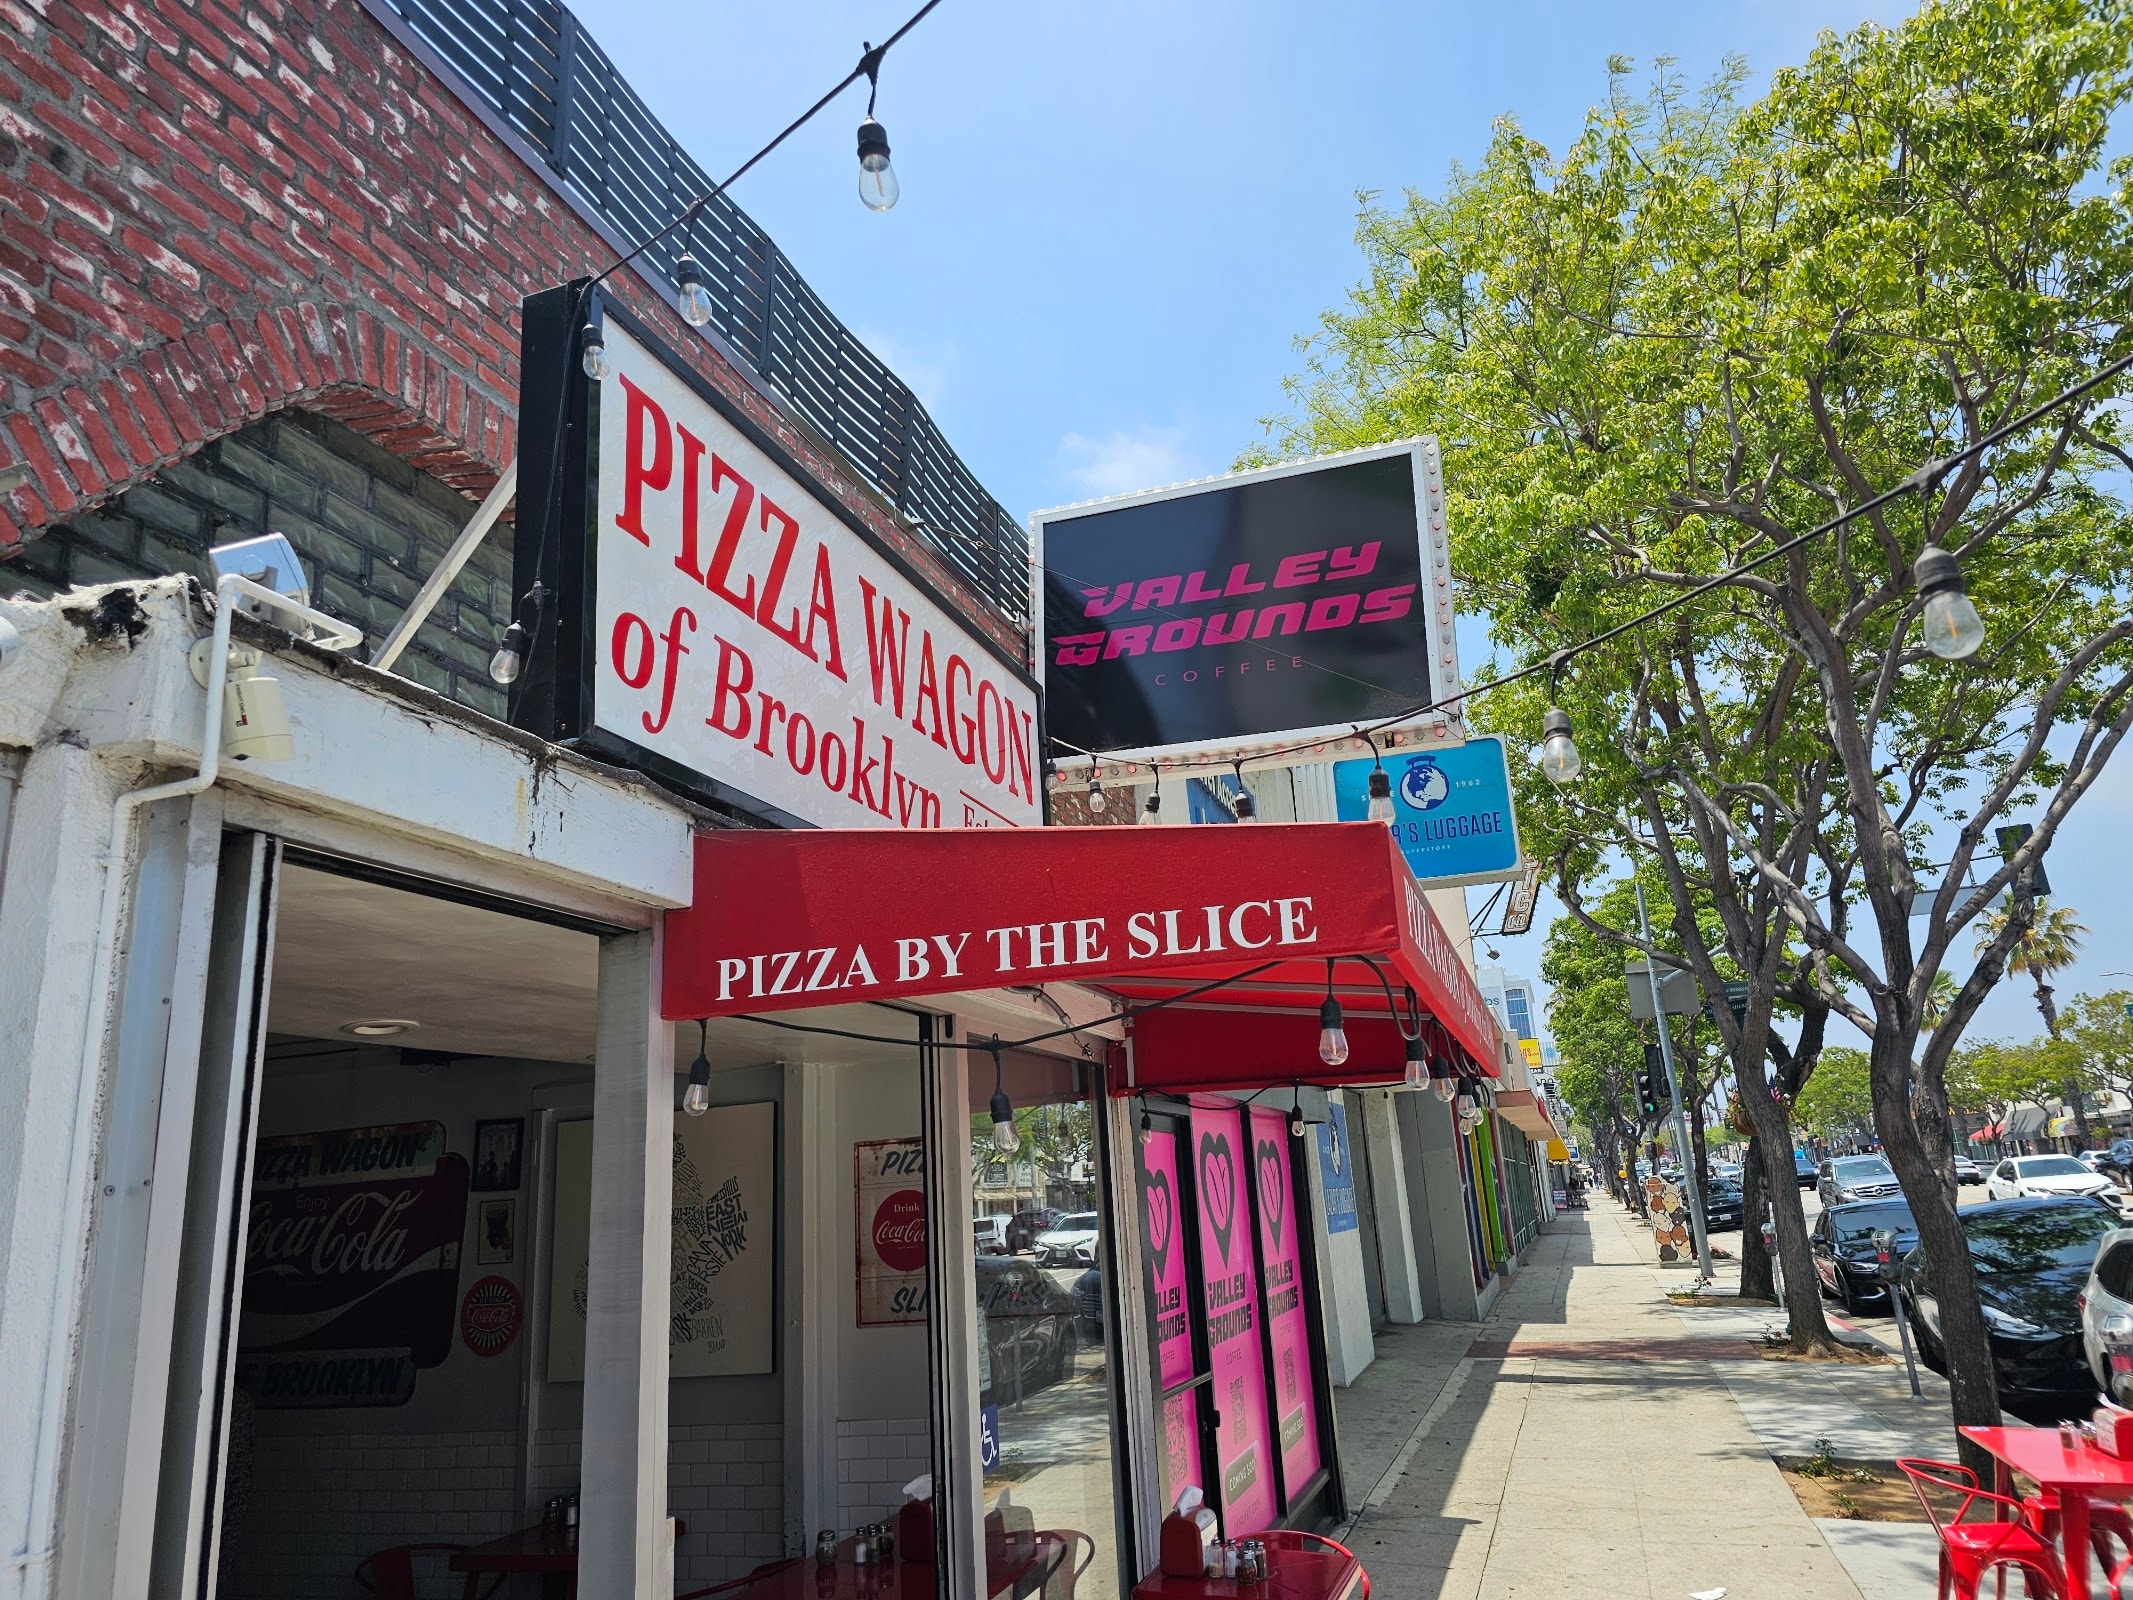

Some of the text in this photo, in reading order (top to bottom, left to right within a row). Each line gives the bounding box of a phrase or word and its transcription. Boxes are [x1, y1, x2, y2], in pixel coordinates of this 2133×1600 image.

[615, 372, 1034, 806] PIZZA WAGON
[1079, 540, 1382, 618] VALLEY
[1050, 583, 1416, 666] GROUNDS
[611, 606, 697, 735] of
[1154, 656, 1303, 686] COFFEE
[1455, 779, 1481, 788] 1962
[1424, 811, 1503, 841] LUGGAGE
[1402, 874, 1437, 973] PIZZA
[715, 896, 1319, 1001] PIZZA BY THE SLICE
[320, 1134, 418, 1175] WAGON
[880, 1148, 924, 1176] PIZ
[296, 1194, 330, 1212] Enjoy
[705, 1193, 742, 1222] EAST
[894, 1202, 920, 1213] Drink
[707, 1210, 748, 1236] NEW
[876, 1218, 926, 1245] Coca-Col
[712, 1225, 747, 1261] YORK
[1264, 1259, 1293, 1290] VALLEY
[1207, 1272, 1246, 1311] VALLEY
[1267, 1285, 1299, 1321] GROUNDS
[691, 1313, 724, 1342] BARREN
[1208, 1303, 1252, 1349] GROUNDS
[1160, 1349, 1175, 1365] COFFEE
[1226, 1347, 1242, 1366] COFFEE
[262, 1357, 409, 1396] BROOKLYN
[1229, 1466, 1247, 1492] COMING
